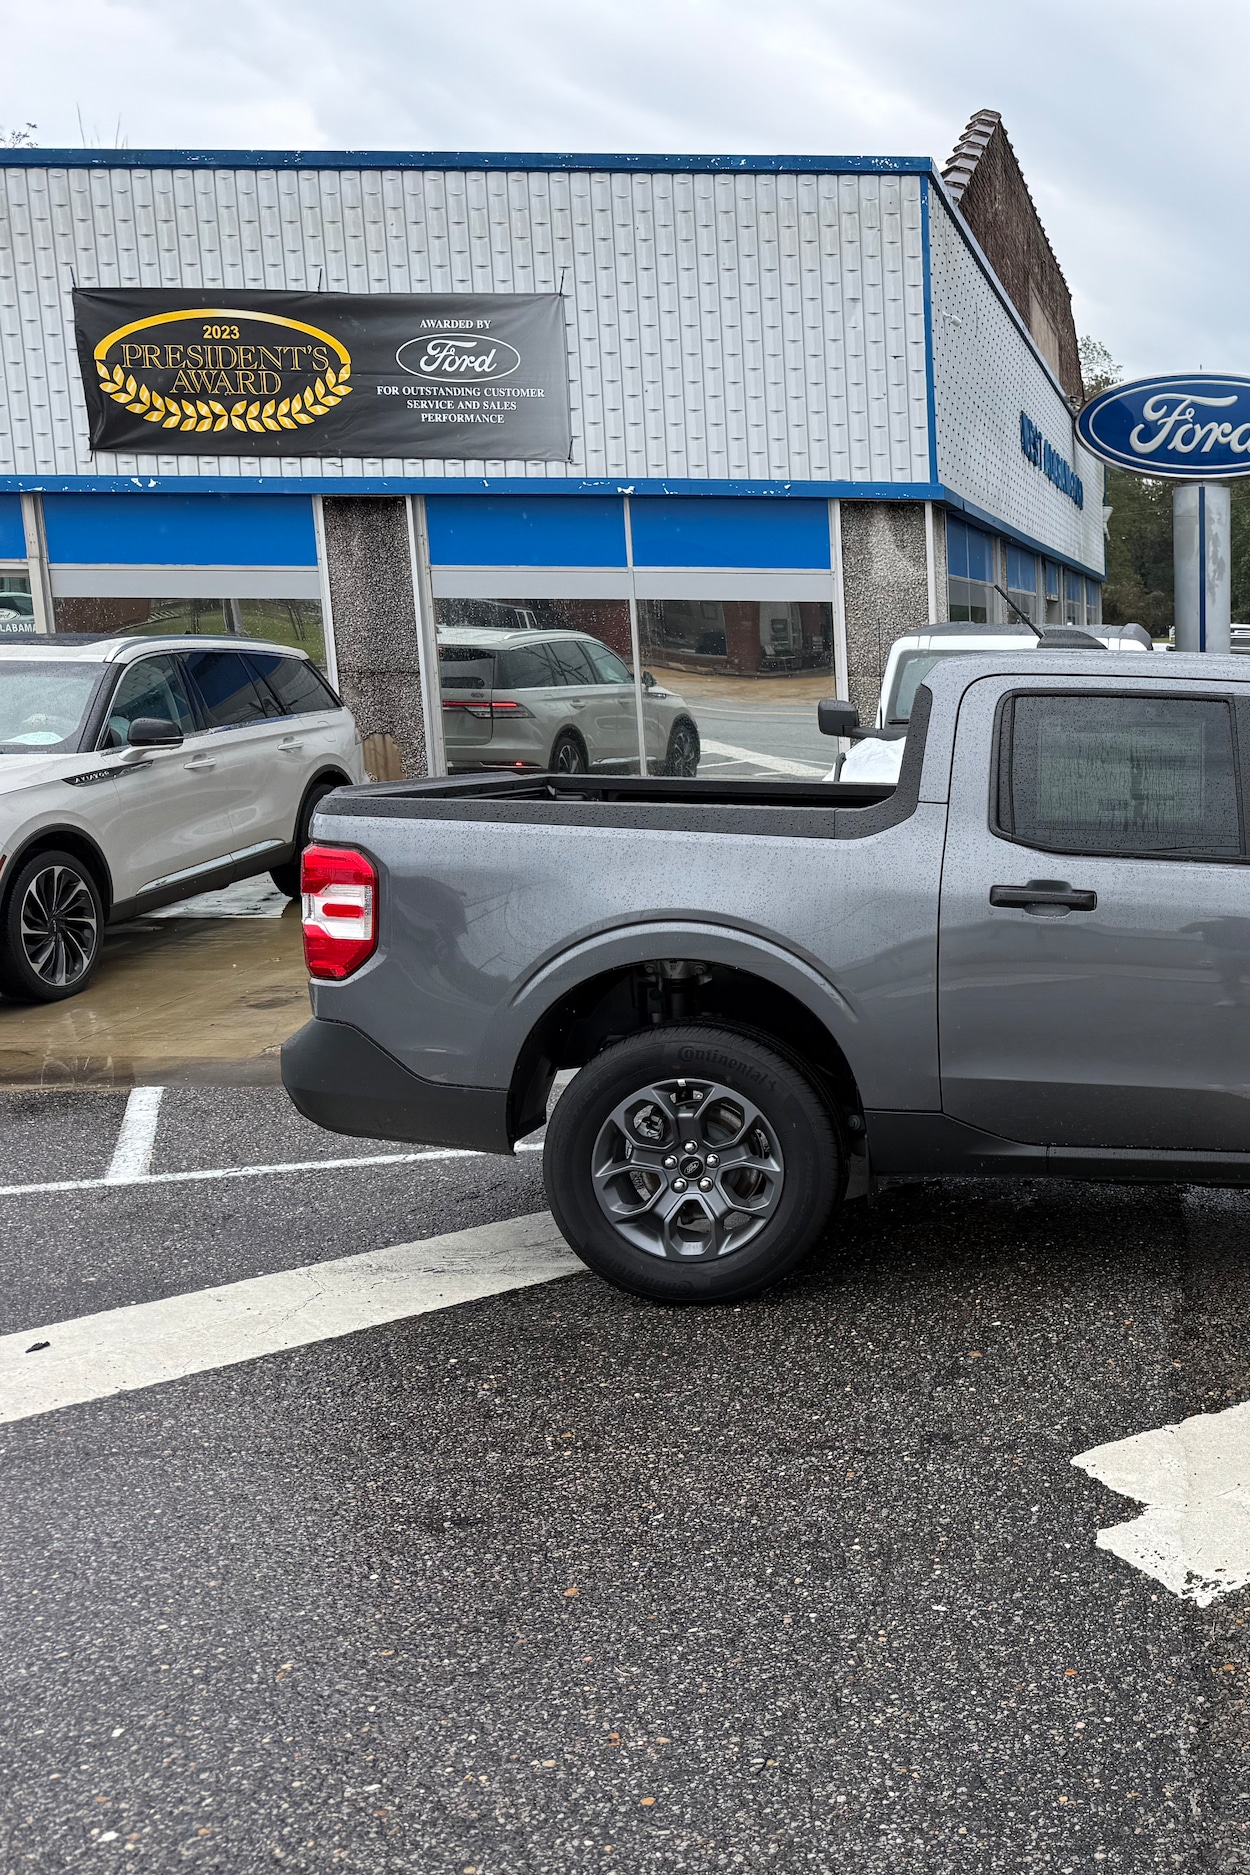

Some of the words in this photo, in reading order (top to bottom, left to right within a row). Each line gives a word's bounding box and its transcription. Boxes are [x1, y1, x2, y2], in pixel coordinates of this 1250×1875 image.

[420, 319, 474, 329] AWARDED
[476, 319, 491, 329] BY
[203, 325, 240, 340] 2023
[121, 343, 329, 371] PRESIDENT'S
[419, 339, 498, 373] Ford
[169, 369, 282, 395] AWARD
[376, 385, 400, 395] FOR
[402, 386, 481, 397] OUTSTANDING
[484, 387, 545, 398] CUSTOMER
[406, 399, 455, 409] SERVICE
[457, 400, 481, 410] AND
[482, 400, 517, 411] SALES
[420, 412, 505, 424] PERFORMANCE
[678, 1045, 769, 1086] Continental
